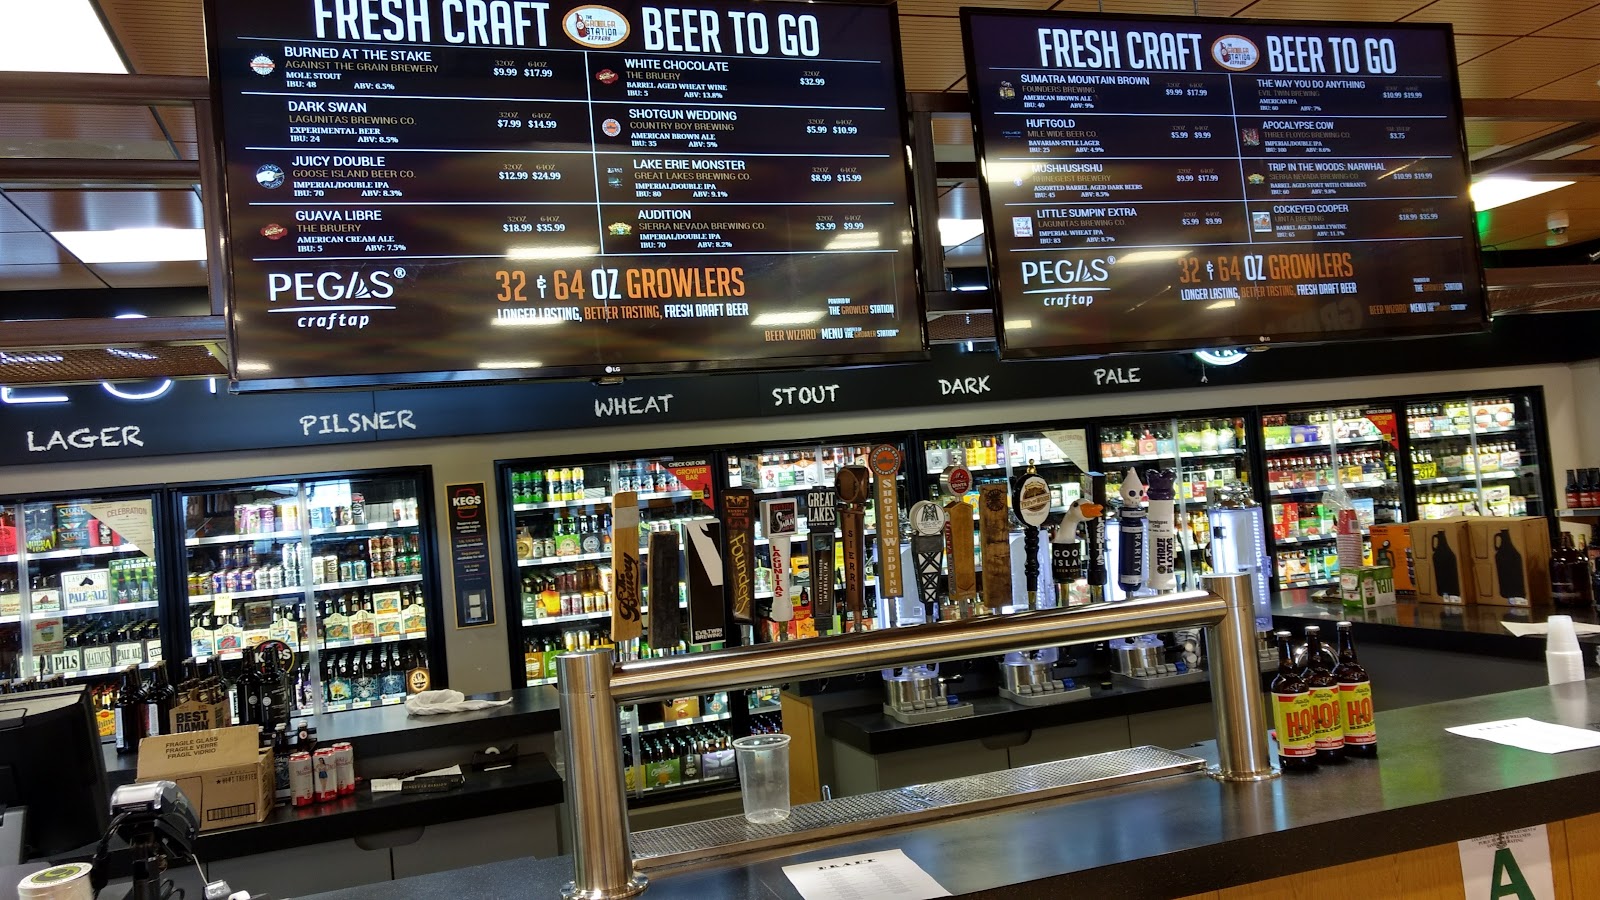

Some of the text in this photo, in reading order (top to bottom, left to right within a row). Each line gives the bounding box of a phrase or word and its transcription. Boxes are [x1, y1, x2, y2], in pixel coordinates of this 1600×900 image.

[314, 0, 549, 46] FRESH CRAFT
[642, 7, 820, 56] BEER TO GO
[284, 46, 432, 62] BURNED AT THE STAKE
[1038, 28, 1202, 70] FRESH CRAFT
[1266, 36, 1397, 74] BEER TO GO
[285, 60, 438, 72] AGAINST THE GRAIN BREWERY
[624, 58, 729, 71] WHITE CHOCOLATE
[493, 67, 553, 77] $9.99 $17.99
[626, 71, 680, 80] THE BRUERY
[800, 77, 825, 86] $32.99
[1021, 74, 1150, 85] SUMATRA MOUNTAIN BROWN
[1257, 79, 1274, 87] THE
[1294, 80, 1311, 88] YOU
[1312, 80, 1324, 88] DO
[1325, 80, 1365, 89] ANYTHING
[288, 101, 367, 113] DARK SWAN
[289, 115, 348, 123] LAGUNITAS
[351, 116, 398, 124] BREWING
[629, 109, 737, 121] SHOTGUN WEDDING
[497, 119, 557, 128] $7.99 $14.99
[675, 122, 692, 130] BOY
[1026, 119, 1075, 128] HUFTGOLD
[1263, 121, 1334, 129] APOCALYPSE COW
[833, 126, 857, 134] $10.99
[292, 156, 385, 167] JUICY DOUBLE
[633, 159, 745, 170] LAKE ERIE MONSTER
[1268, 163, 1386, 171] TRIP IN THE WOODS: NARWHAL
[1032, 163, 1103, 173] MUSHHUSHSHU
[293, 170, 329, 178] GOOSE
[331, 170, 369, 178] ISLAND
[371, 170, 397, 178] BEER
[499, 171, 561, 180] $12.99 $24.99
[666, 172, 694, 180] LAKES
[811, 174, 862, 182] $8.99 $15.99
[1037, 209, 1068, 218] LITTLE
[1108, 208, 1137, 216] EXTRA
[1273, 204, 1349, 213] COCKEYED COOPER
[295, 210, 382, 221] GUAVA LIBRE
[638, 210, 691, 219] AUDITION
[296, 224, 361, 232] THE BRUERY
[503, 224, 565, 232] $18.99 $35.99
[639, 222, 671, 230] SIERRA
[673, 222, 709, 230] NEVADA
[711, 222, 750, 230] BREWING
[815, 222, 864, 230] $5.99 $9.99
[1178, 260, 1200, 283] 32
[1218, 257, 1241, 282] 64
[1244, 255, 1266, 281] OZ
[1269, 252, 1353, 280] GROWLERS
[496, 270, 527, 301] 32
[554, 270, 585, 300] 64
[591, 269, 621, 299] OZ
[626, 267, 745, 298] GROWLERS
[1044, 294, 1093, 308] craftap
[498, 303, 749, 322] LONGER LASTING, BETTER TASTING, FRESH DRAFT BEER
[297, 313, 370, 329] craftap
[765, 330, 785, 341] BEER
[821, 328, 843, 340] MENU
[1094, 367, 1141, 386] PALE
[938, 374, 991, 396] DARK
[772, 385, 840, 406] STOUT
[594, 394, 674, 418] WHEAT
[299, 409, 416, 436] PILSNER
[26, 425, 144, 453] LAGER
[685, 473, 698, 481] BAR
[452, 496, 481, 507] KEGS
[808, 492, 835, 508] GREAT
[59, 507, 87, 517] STONE
[106, 507, 147, 518] CELEBRATION
[882, 479, 894, 535] SHOTGUN
[808, 507, 835, 522] LAKES
[61, 530, 88, 541] STONE
[883, 537, 898, 594] WEDDING
[730, 533, 750, 615] Founders
[772, 545, 784, 598] LAGUNITAS
[69, 590, 107, 603] PALE ALE
[55, 655, 78, 670] PILS
[176, 710, 209, 723] BEST
[165, 736, 219, 748] FRAGILE GLASS
[165, 742, 218, 754] FRAGILE VERRE
[194, 747, 216, 756] VIDRIO
[1490, 847, 1536, 900] A
